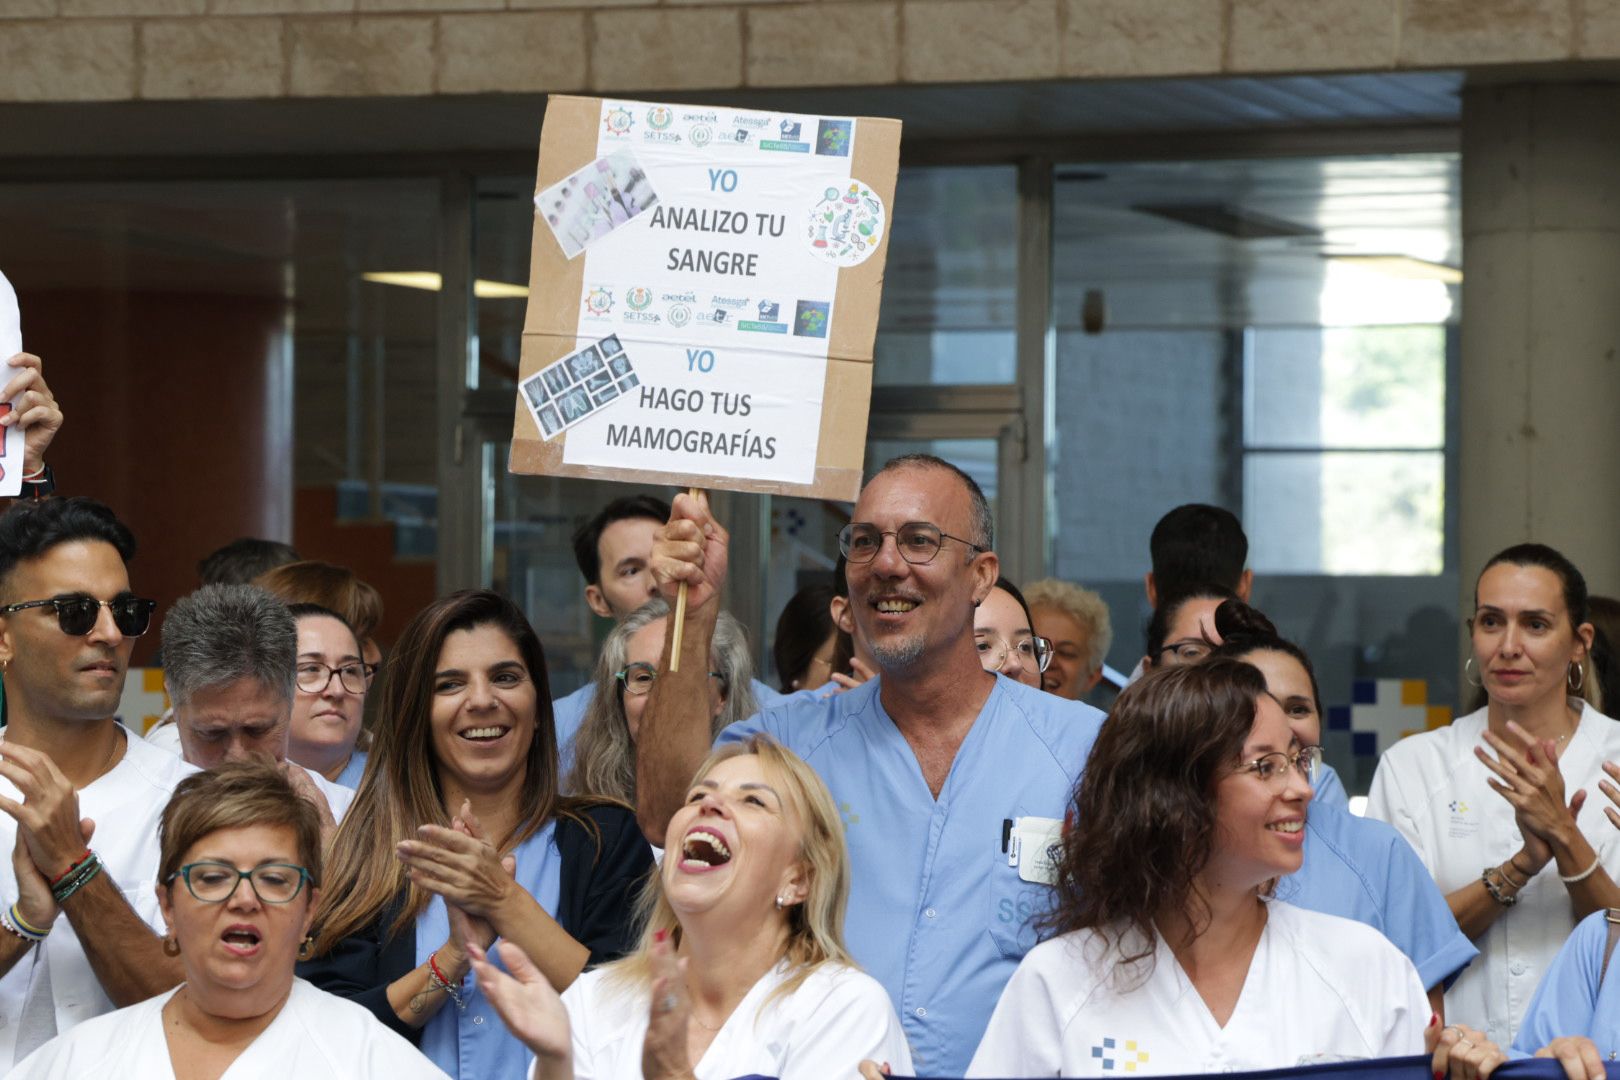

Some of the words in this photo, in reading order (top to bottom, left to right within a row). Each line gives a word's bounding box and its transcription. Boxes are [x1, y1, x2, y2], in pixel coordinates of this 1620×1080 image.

[707, 168, 738, 193] YO
[649, 205, 749, 235] ANALIZO
[755, 213, 786, 238] TU
[666, 248, 759, 277] SANGRE
[685, 348, 715, 373] YO
[639, 385, 704, 413] HAGO
[710, 391, 752, 417] TUS
[606, 423, 777, 460] MAMOGRAFÍAS
